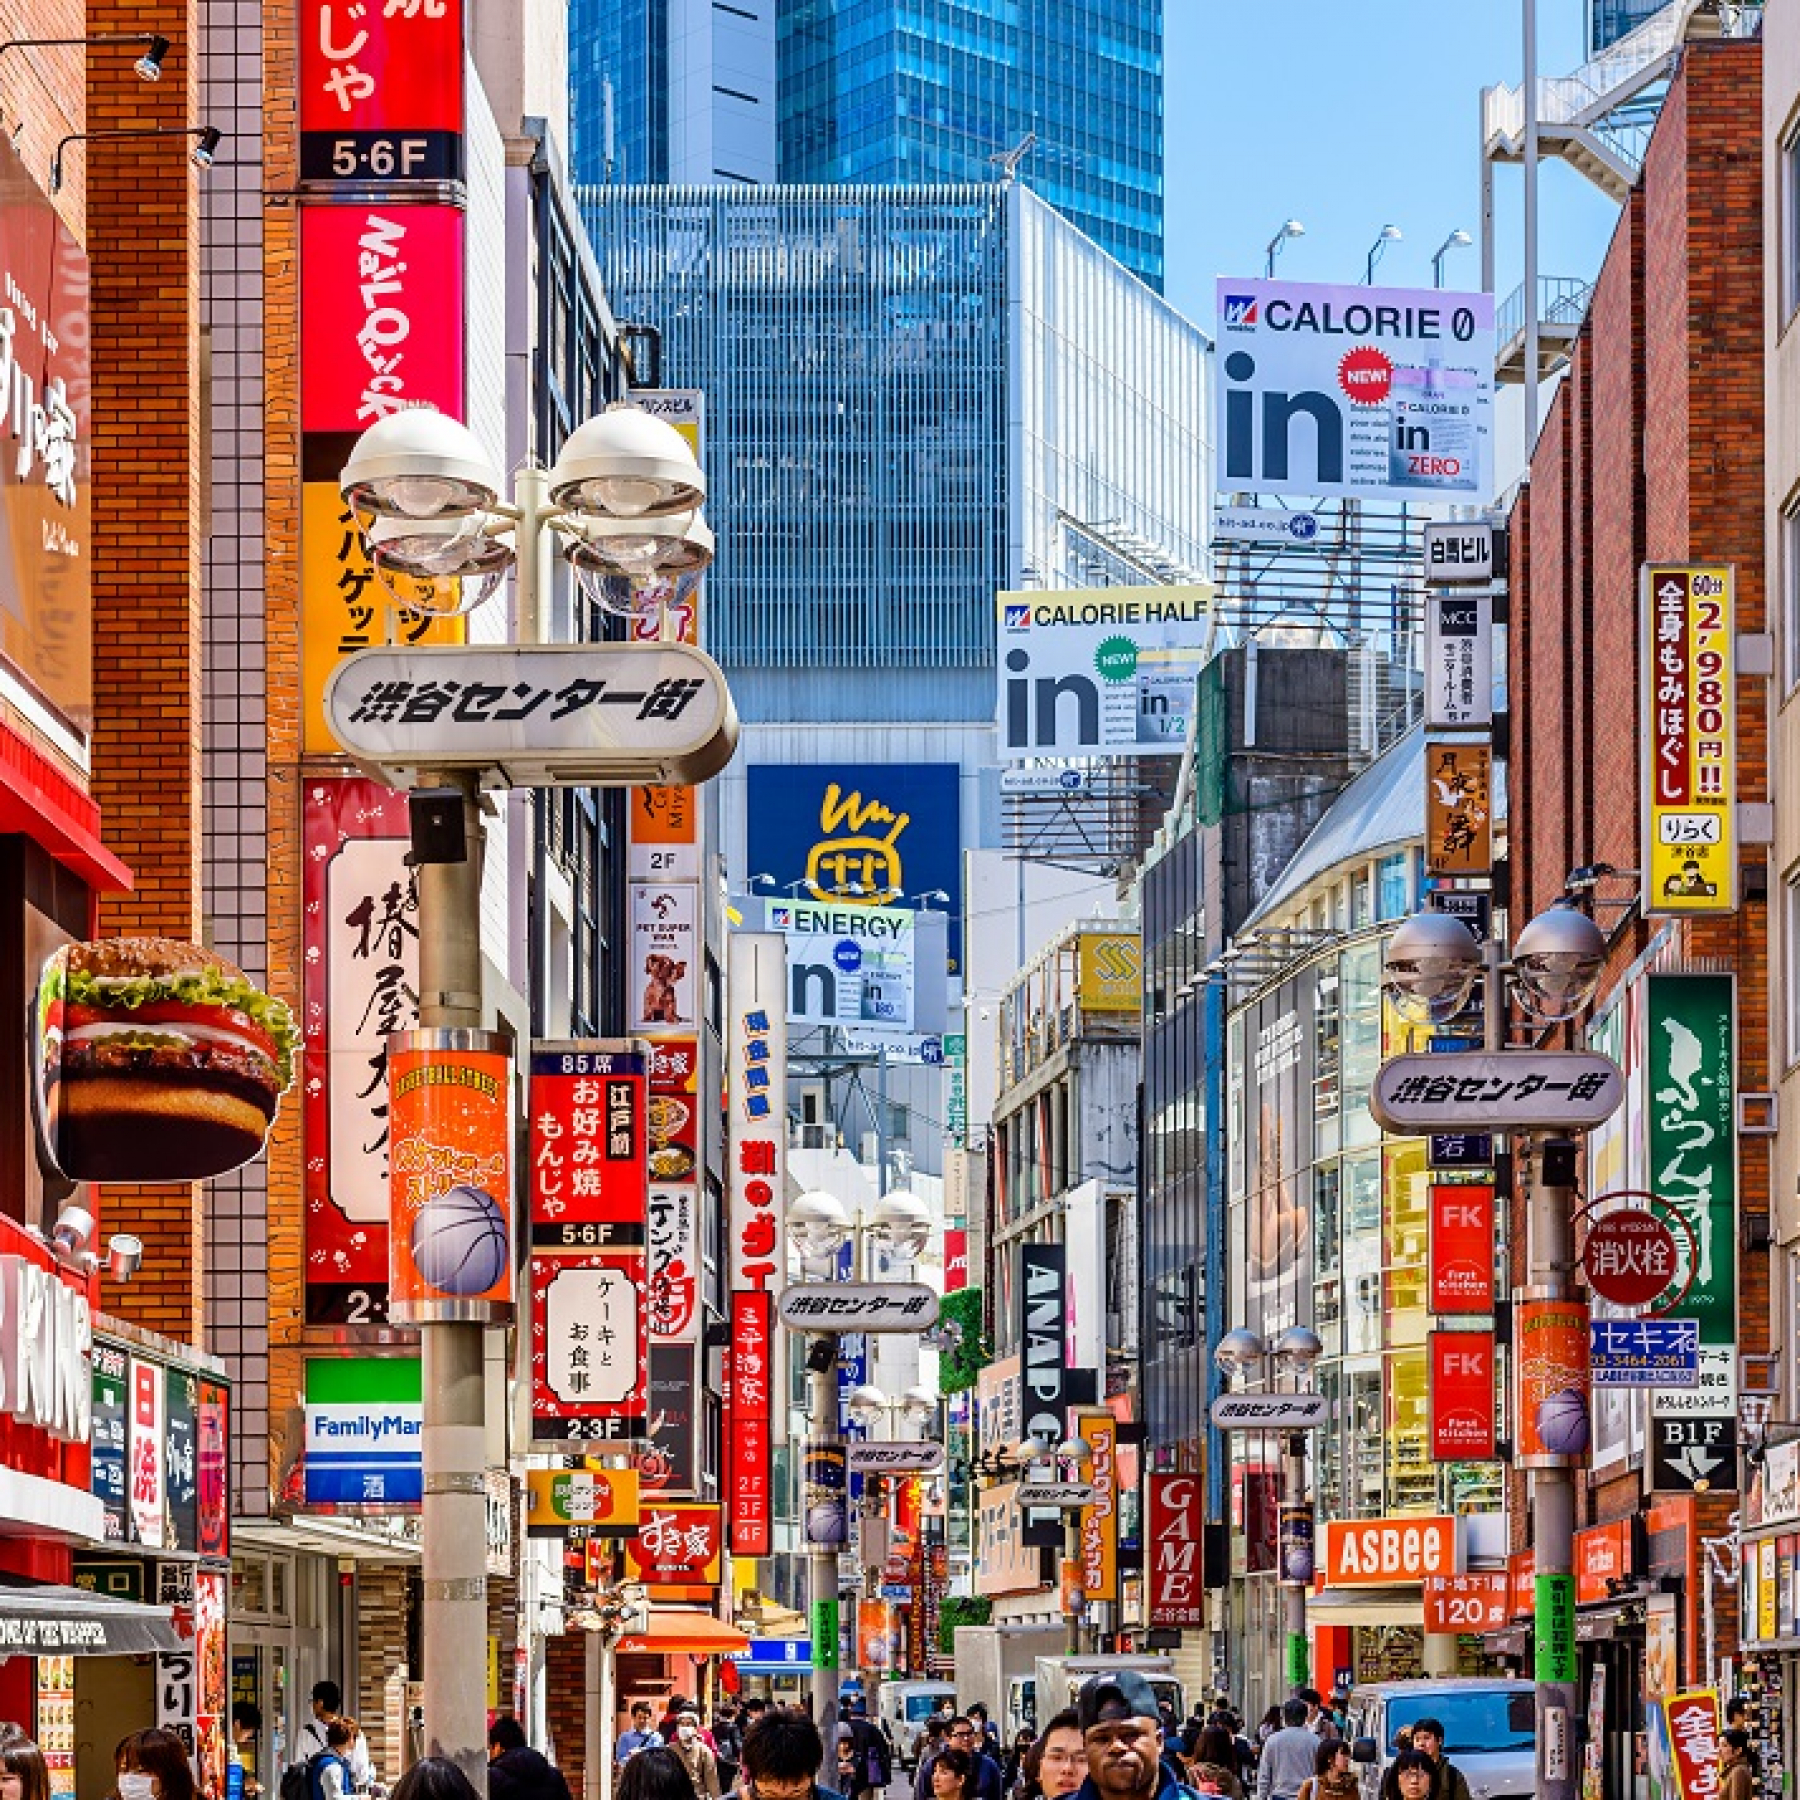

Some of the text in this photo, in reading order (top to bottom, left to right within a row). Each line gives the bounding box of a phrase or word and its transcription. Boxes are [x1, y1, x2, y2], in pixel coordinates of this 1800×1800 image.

[1265, 299, 1475, 342] CALORIE 0
[1224, 350, 1344, 483] in
[1396, 416, 1430, 450] in
[1408, 456, 1460, 476] ZERO
[1034, 600, 1208, 626] CALORIE HALF
[348, 677, 706, 723] 渋谷センター街
[1006, 648, 1099, 748] in
[1657, 580, 1685, 798] 全身もみほぐし
[1665, 819, 1713, 841] りらく
[650, 852, 677, 869] 2F
[794, 909, 904, 940] ENERGY
[562, 1054, 613, 1074] 85席
[1389, 1072, 1611, 1103] 渋谷センター街
[610, 1084, 632, 1157] 江戸前
[571, 1077, 602, 1197] お好み焼
[1441, 1205, 1483, 1227] FK
[1591, 1239, 1670, 1276] 消火栓
[785, 1297, 929, 1315] 渋谷センター街
[597, 1277, 616, 1367] ケーキと
[1026, 1264, 1062, 1401] ANAP
[1600, 1323, 1695, 1353] セキネ
[567, 1322, 592, 1395] お食事
[1442, 1353, 1483, 1376] FK
[315, 1415, 422, 1441] FamilyMar
[1663, 1421, 1723, 1445] B1F
[362, 1473, 385, 1498] 酒
[738, 1476, 763, 1492] 2F
[738, 1501, 763, 1517] 3F
[637, 1509, 711, 1562] すき家
[738, 1526, 763, 1542] 4F
[1155, 1478, 1199, 1604] GAME
